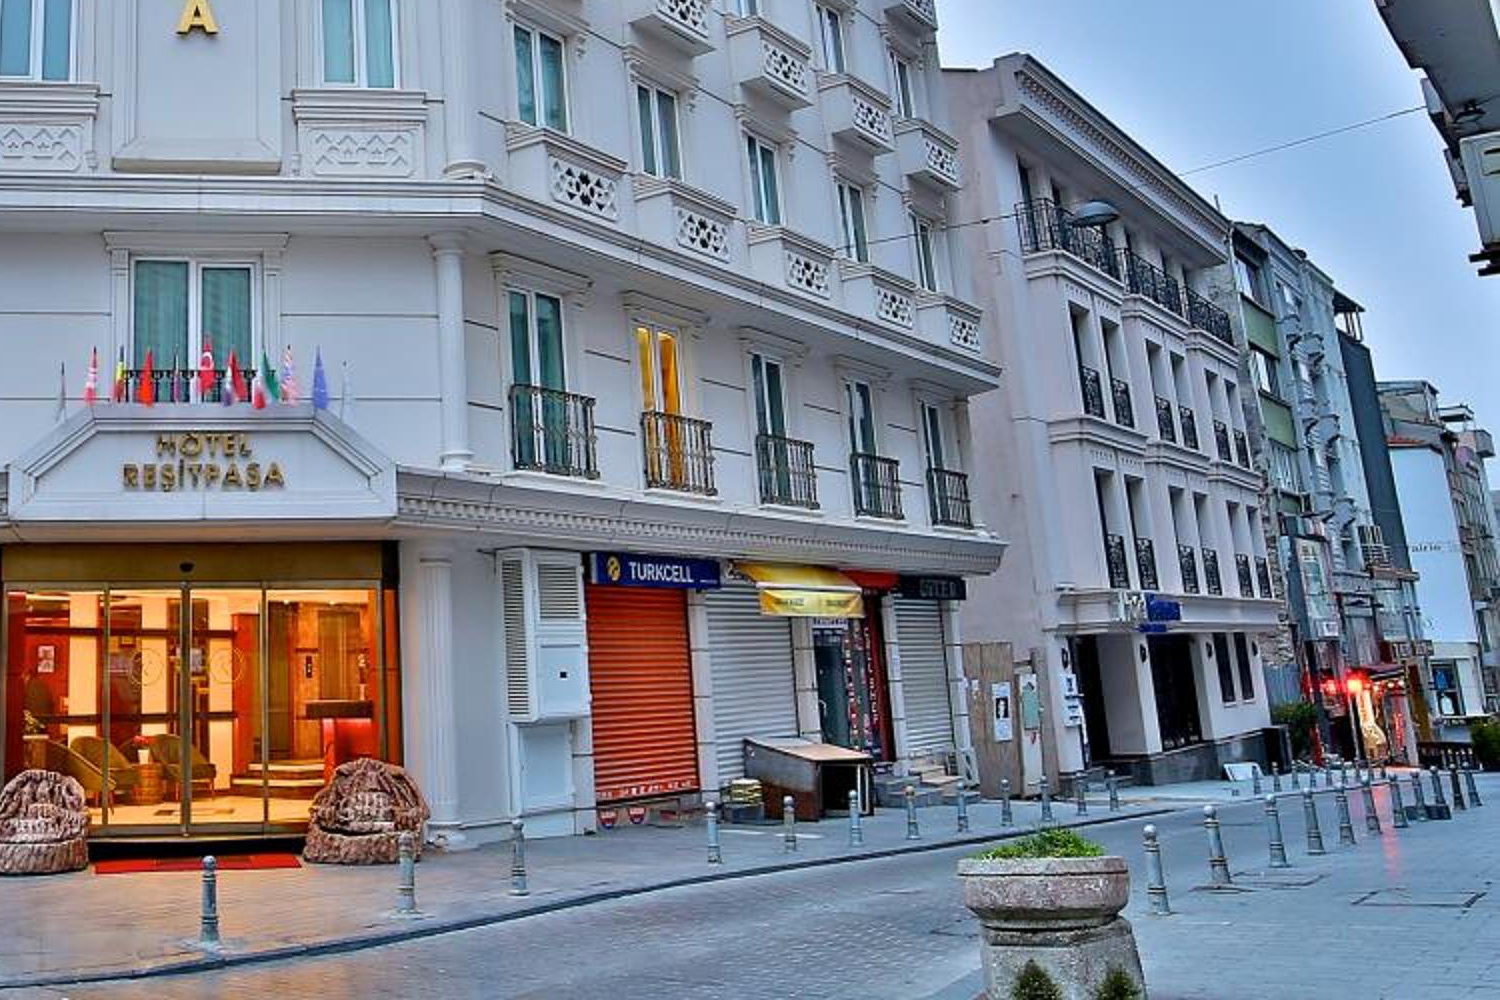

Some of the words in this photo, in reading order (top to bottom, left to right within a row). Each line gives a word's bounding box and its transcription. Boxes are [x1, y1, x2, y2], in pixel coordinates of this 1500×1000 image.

[156, 431, 253, 457] HOTEL
[123, 459, 286, 492] REŞİTPAŞA
[628, 561, 694, 583] TURKCELL
